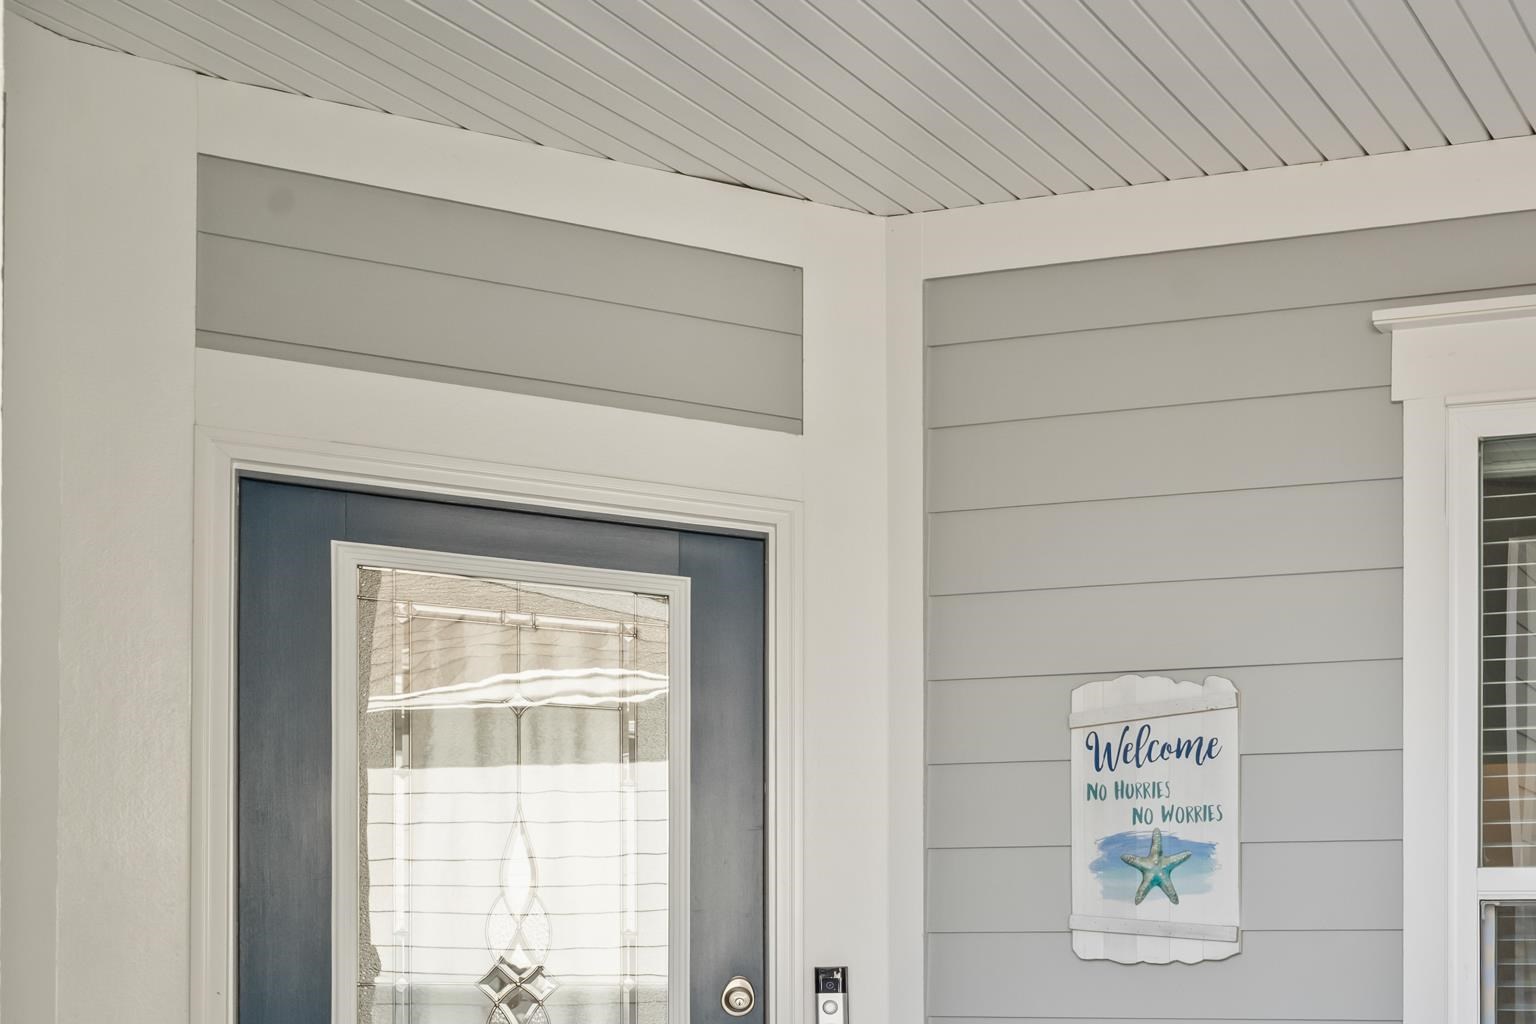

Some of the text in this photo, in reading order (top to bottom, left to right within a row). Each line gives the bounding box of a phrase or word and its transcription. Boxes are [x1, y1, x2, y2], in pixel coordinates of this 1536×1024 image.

[1086, 724, 1222, 772] Welcome
[1086, 780, 1170, 801] NO HURRIES
[1132, 804, 1223, 825] NO WORRIES
